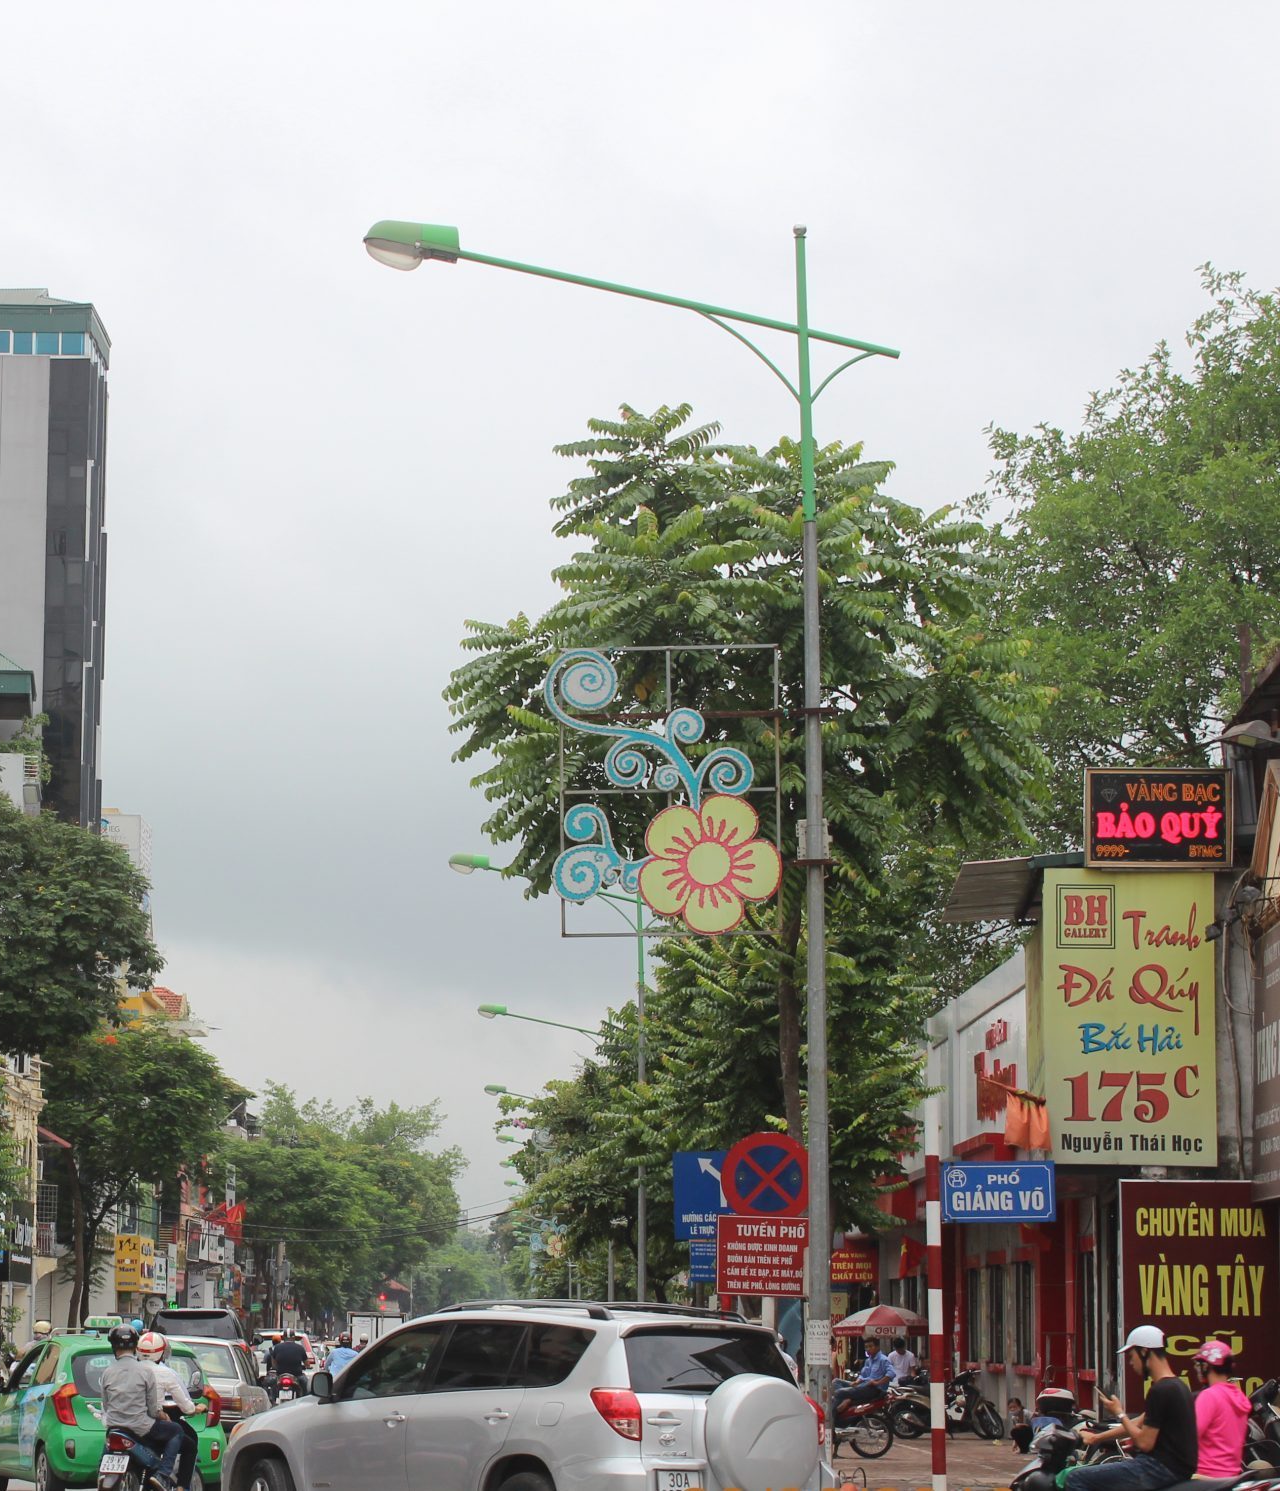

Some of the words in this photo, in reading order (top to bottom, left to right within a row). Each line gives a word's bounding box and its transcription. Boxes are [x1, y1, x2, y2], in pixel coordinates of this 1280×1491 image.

[1125, 778, 1178, 801] VÀNG
[1182, 783, 1221, 805] BẠC
[1096, 802, 1157, 838] BẢO
[1161, 805, 1222, 844] QUÝ
[1189, 845, 1223, 858] BTMC
[1064, 895, 1108, 926] BH
[1064, 928, 1108, 939] GALLERY
[1122, 902, 1202, 951] Tranh
[1057, 964, 1115, 1007] Đá
[1078, 1022, 1132, 1054] Bắc
[1137, 1023, 1183, 1056] Hải
[1061, 1131, 1123, 1154] Nguyễn
[1130, 1133, 1166, 1152] Thái
[1172, 1134, 1203, 1156] Học
[987, 1168, 1020, 1185] PHỐ
[952, 1184, 1013, 1212] GIẢNG
[1019, 1186, 1045, 1211] VÕ
[704, 1210, 717, 1222] CÁC
[1135, 1202, 1214, 1237] CHUYÊN
[1220, 1207, 1266, 1237] MUA
[779, 1222, 806, 1239] PHỐ
[757, 1254, 772, 1264] TRÊN
[763, 1243, 778, 1252] KINH
[778, 1244, 798, 1253] DOANH
[727, 1279, 741, 1289] TRÊN
[749, 1268, 757, 1277] XE
[772, 1269, 780, 1278] XE
[1138, 1254, 1210, 1316] VÀNG
[1217, 1254, 1265, 1317] TÂY
[1165, 1330, 1243, 1356] CŨ
[668, 1472, 690, 1488] 30A
